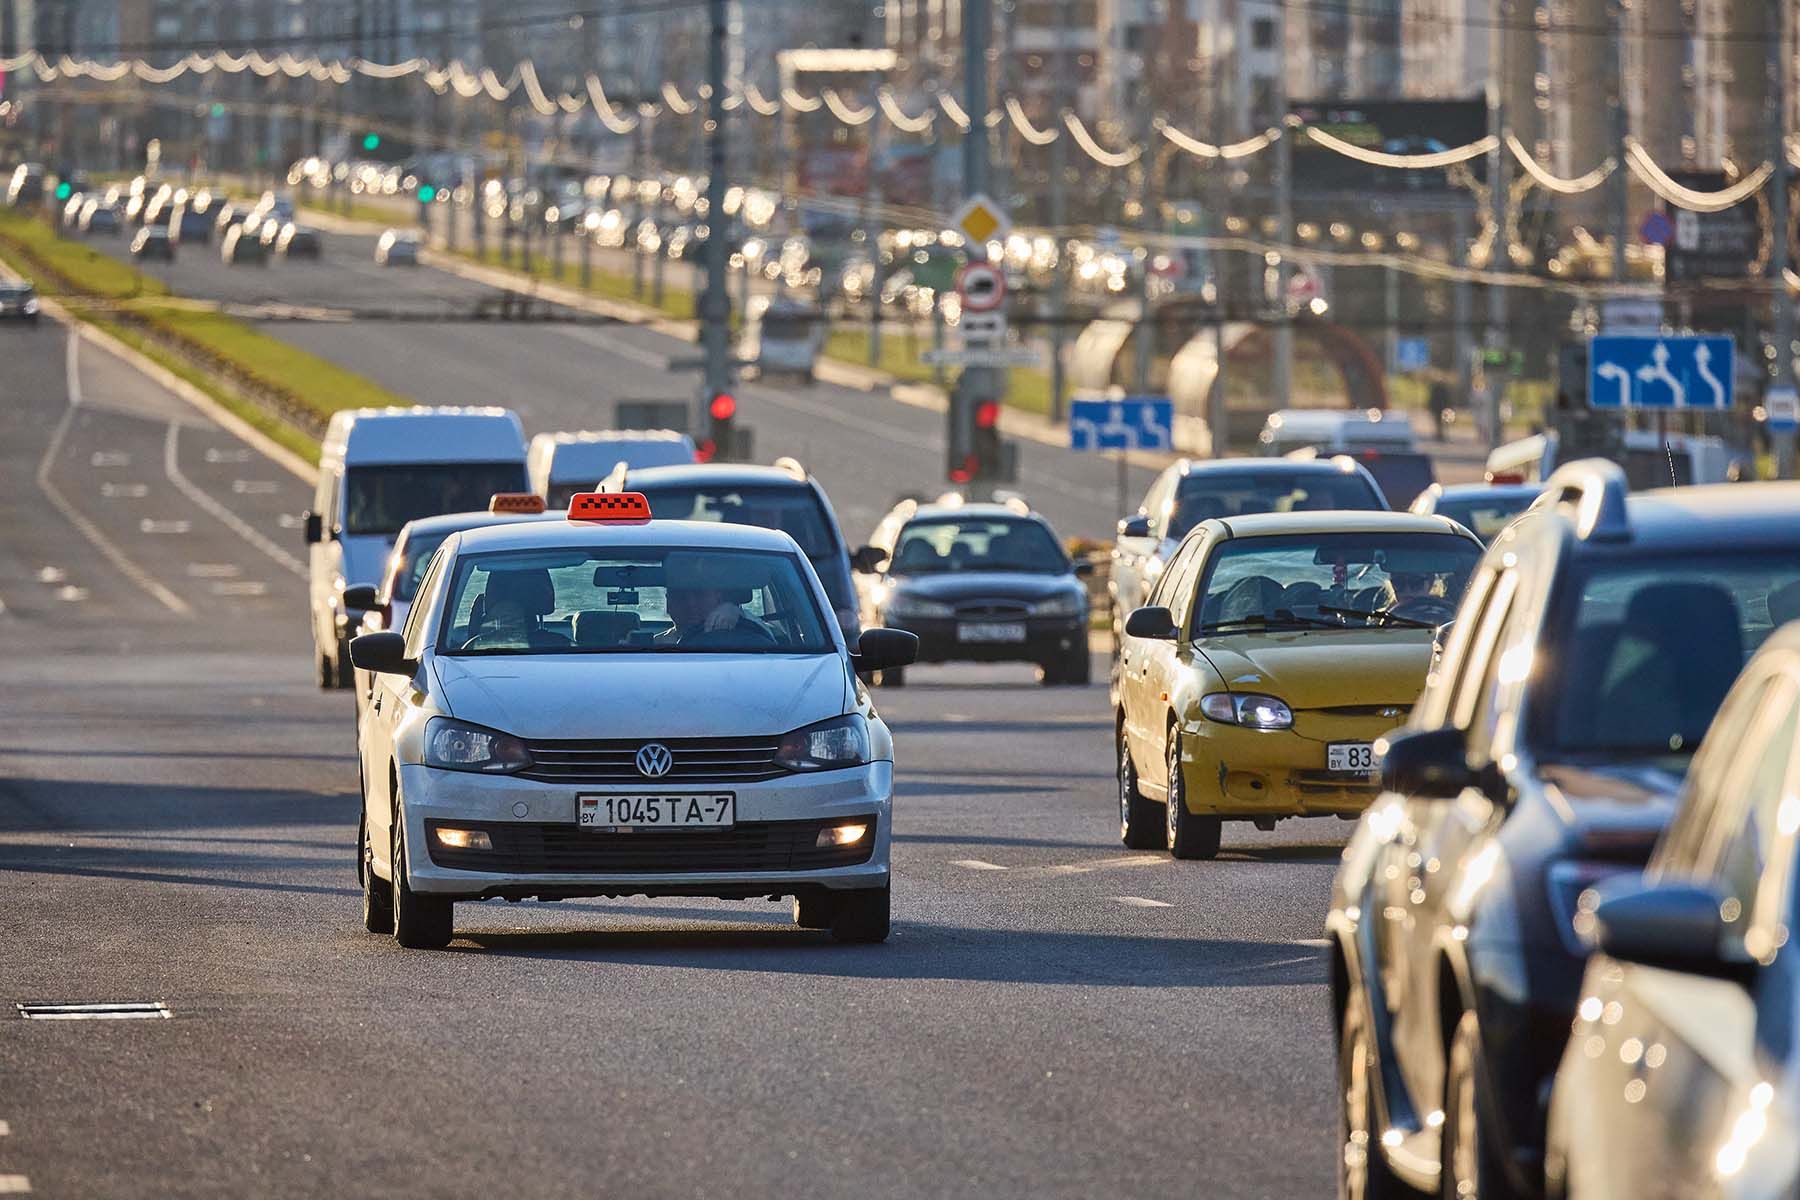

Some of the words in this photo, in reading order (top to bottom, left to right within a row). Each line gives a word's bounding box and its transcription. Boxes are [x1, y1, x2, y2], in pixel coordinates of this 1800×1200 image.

[636, 744, 672, 777] VW
[1330, 760, 1341, 768] BY
[1348, 747, 1380, 768] 83
[582, 813, 595, 823] BY
